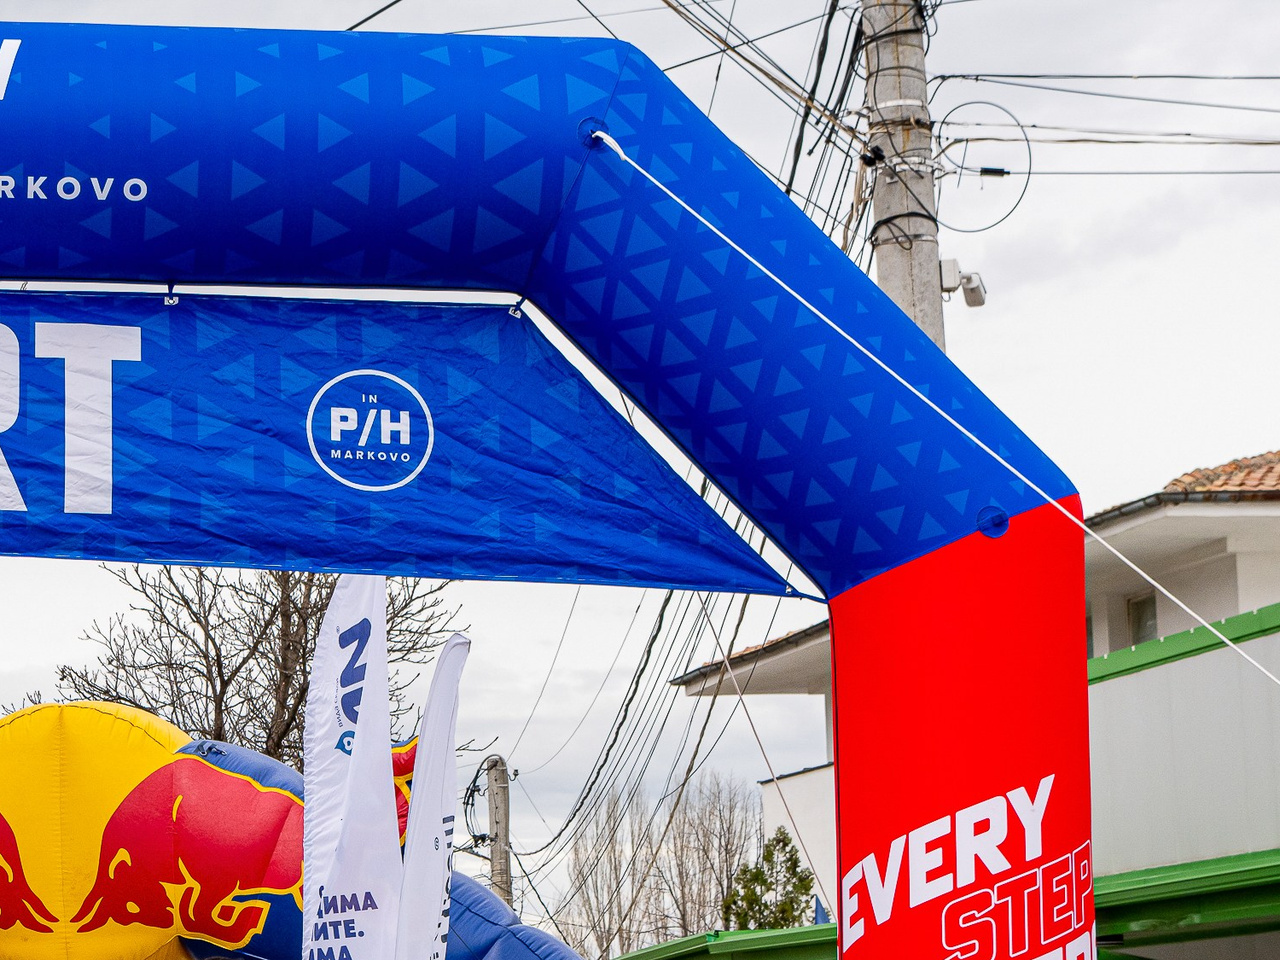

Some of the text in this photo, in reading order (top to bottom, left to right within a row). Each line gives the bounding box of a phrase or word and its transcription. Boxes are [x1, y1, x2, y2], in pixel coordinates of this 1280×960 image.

[362, 393, 378, 404] IN
[330, 406, 411, 447] P/H
[330, 449, 411, 463] MARKOVO
[842, 774, 1055, 953] EVERY
